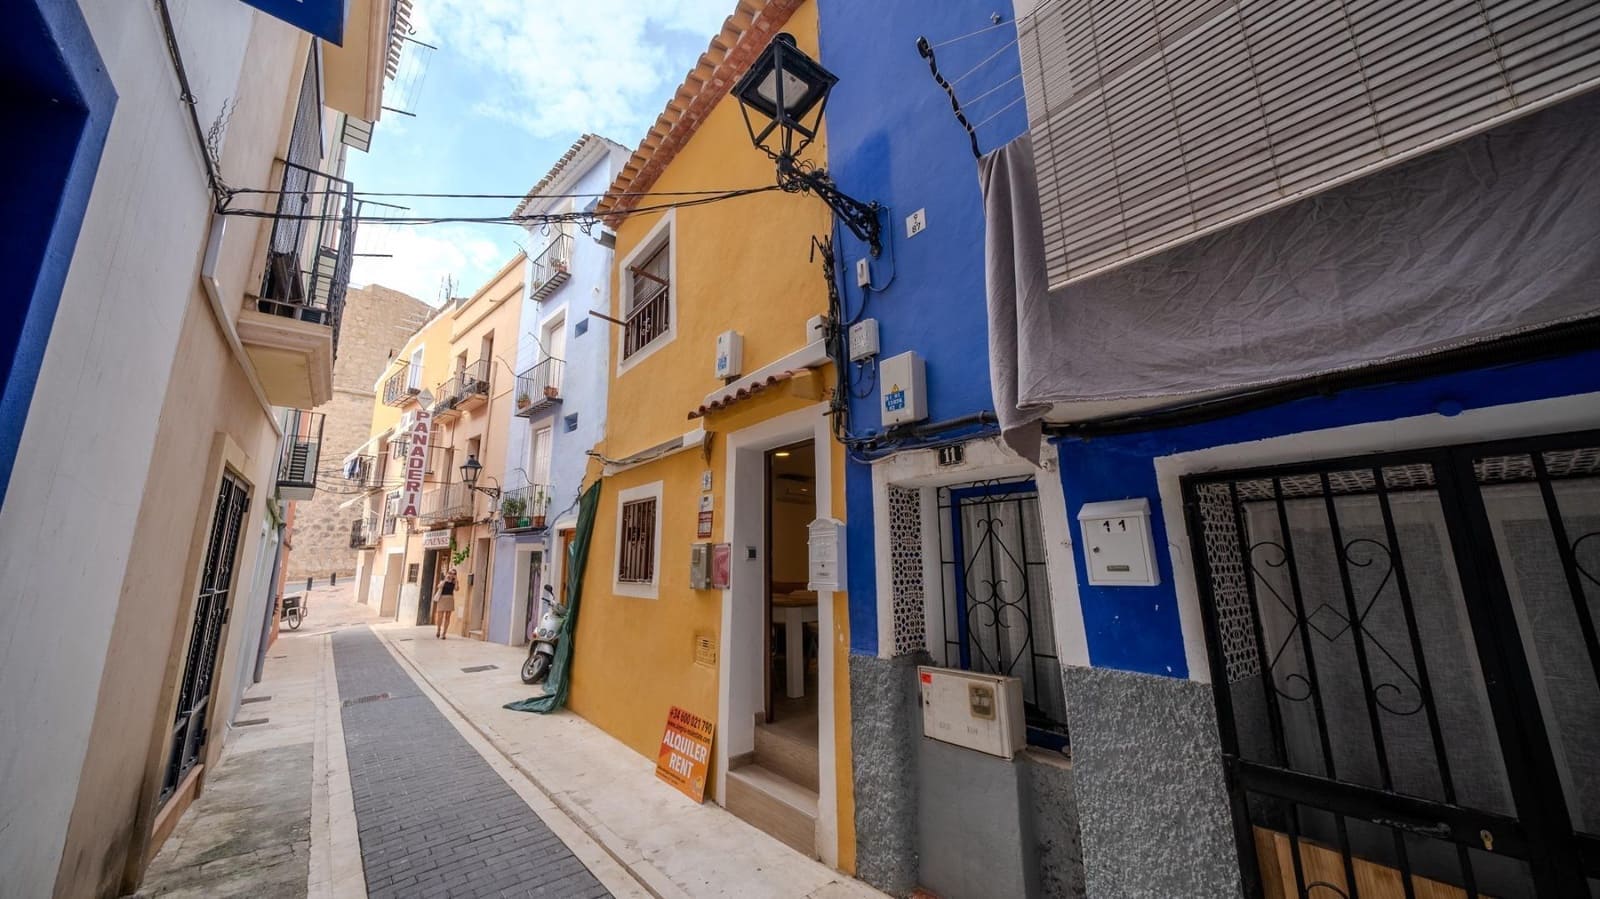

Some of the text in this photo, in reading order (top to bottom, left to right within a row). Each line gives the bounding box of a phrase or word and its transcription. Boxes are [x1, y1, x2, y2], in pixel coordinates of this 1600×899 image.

[403, 411, 430, 516] PANADERIA
[944, 447, 956, 463] 11
[663, 729, 707, 765] ALQUILER
[669, 752, 694, 778] RENT
